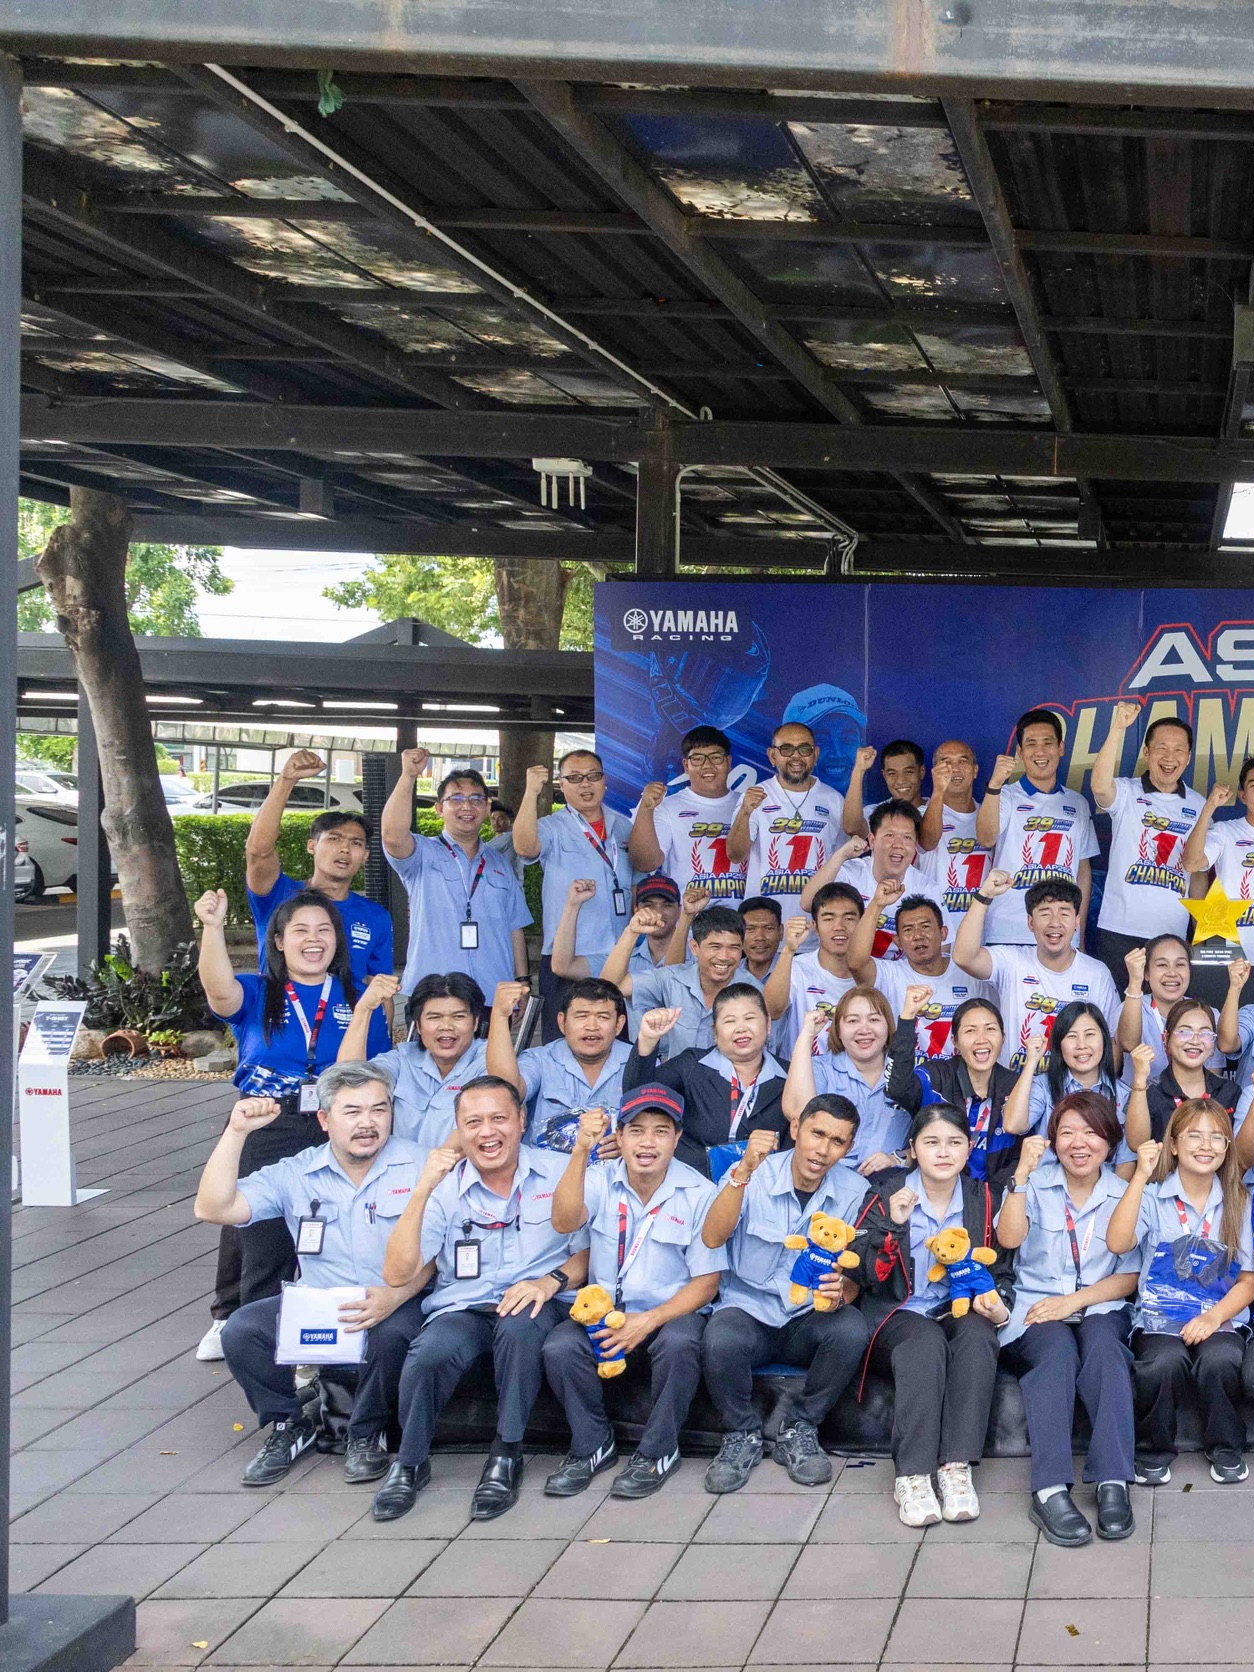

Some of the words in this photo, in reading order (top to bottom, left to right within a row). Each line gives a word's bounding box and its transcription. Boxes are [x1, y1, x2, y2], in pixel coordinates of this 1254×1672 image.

[650, 610, 739, 633] YAMAHA
[689, 822, 723, 838] 39
[769, 817, 803, 835] 39
[1023, 816, 1055, 832] 39
[785, 835, 814, 874] 1
[947, 837, 976, 854] 39
[1038, 832, 1064, 869] 1
[694, 872, 719, 880] ASIA
[961, 854, 986, 892] 1
